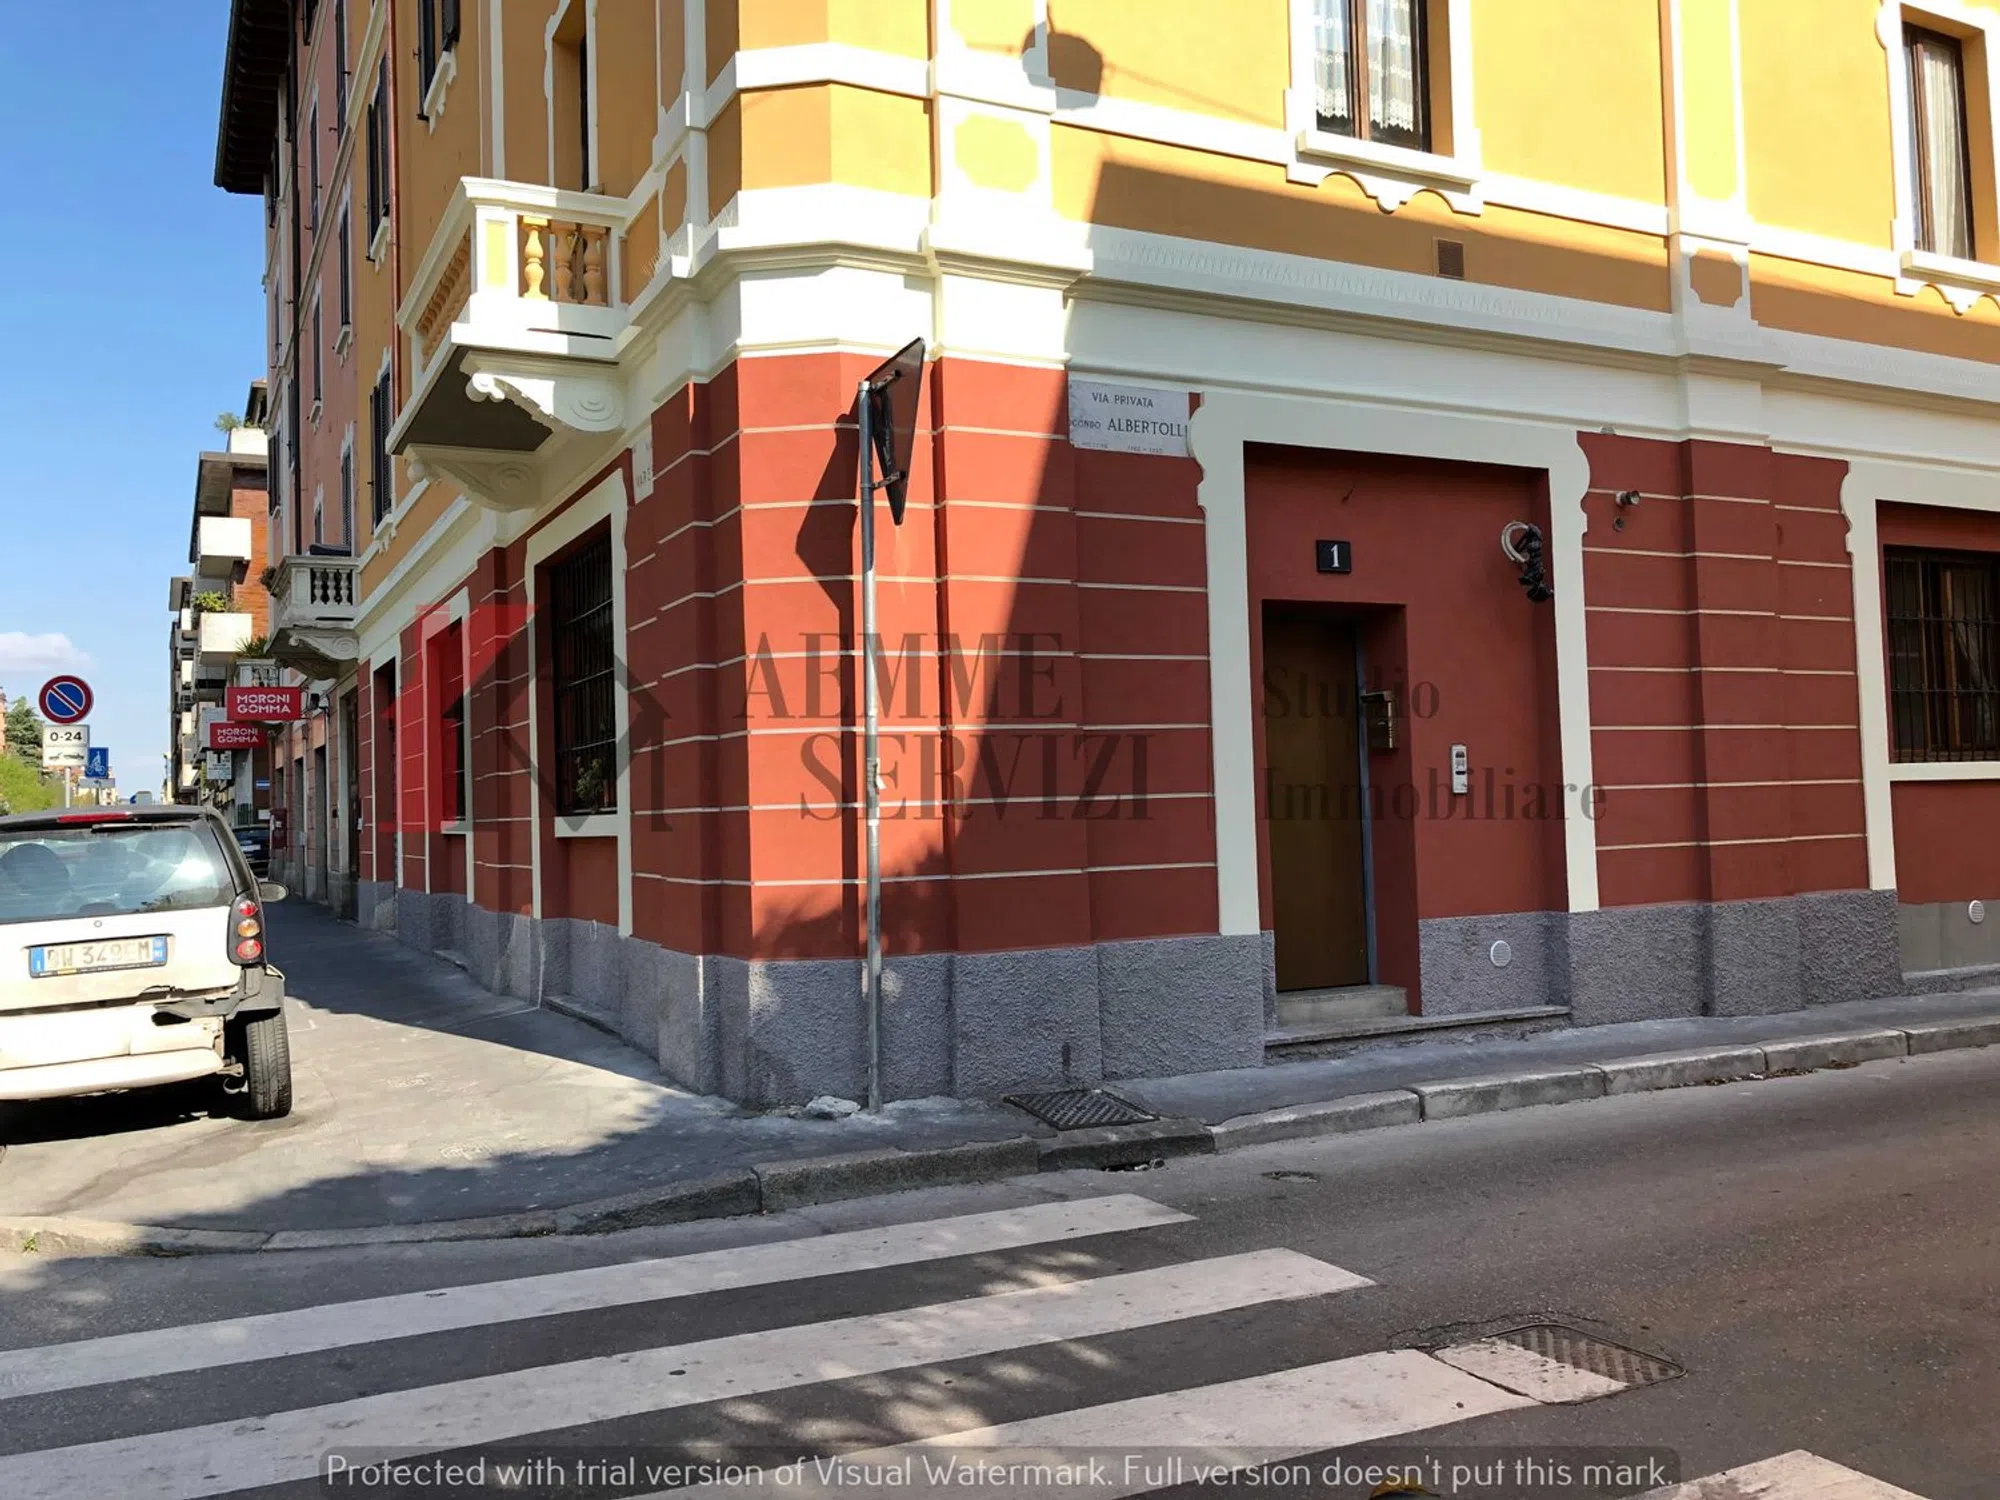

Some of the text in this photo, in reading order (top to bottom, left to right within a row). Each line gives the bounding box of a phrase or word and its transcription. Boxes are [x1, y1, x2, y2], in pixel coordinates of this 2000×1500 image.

[1091, 392, 1154, 408] VIA PRIVATA
[1330, 543, 1341, 568] 1
[236, 693, 291, 704] MORONI
[236, 704, 292, 714] GOMMA
[50, 731, 83, 742] 0-24
[216, 727, 259, 736] MORONI
[216, 735, 260, 743] GOMMA
